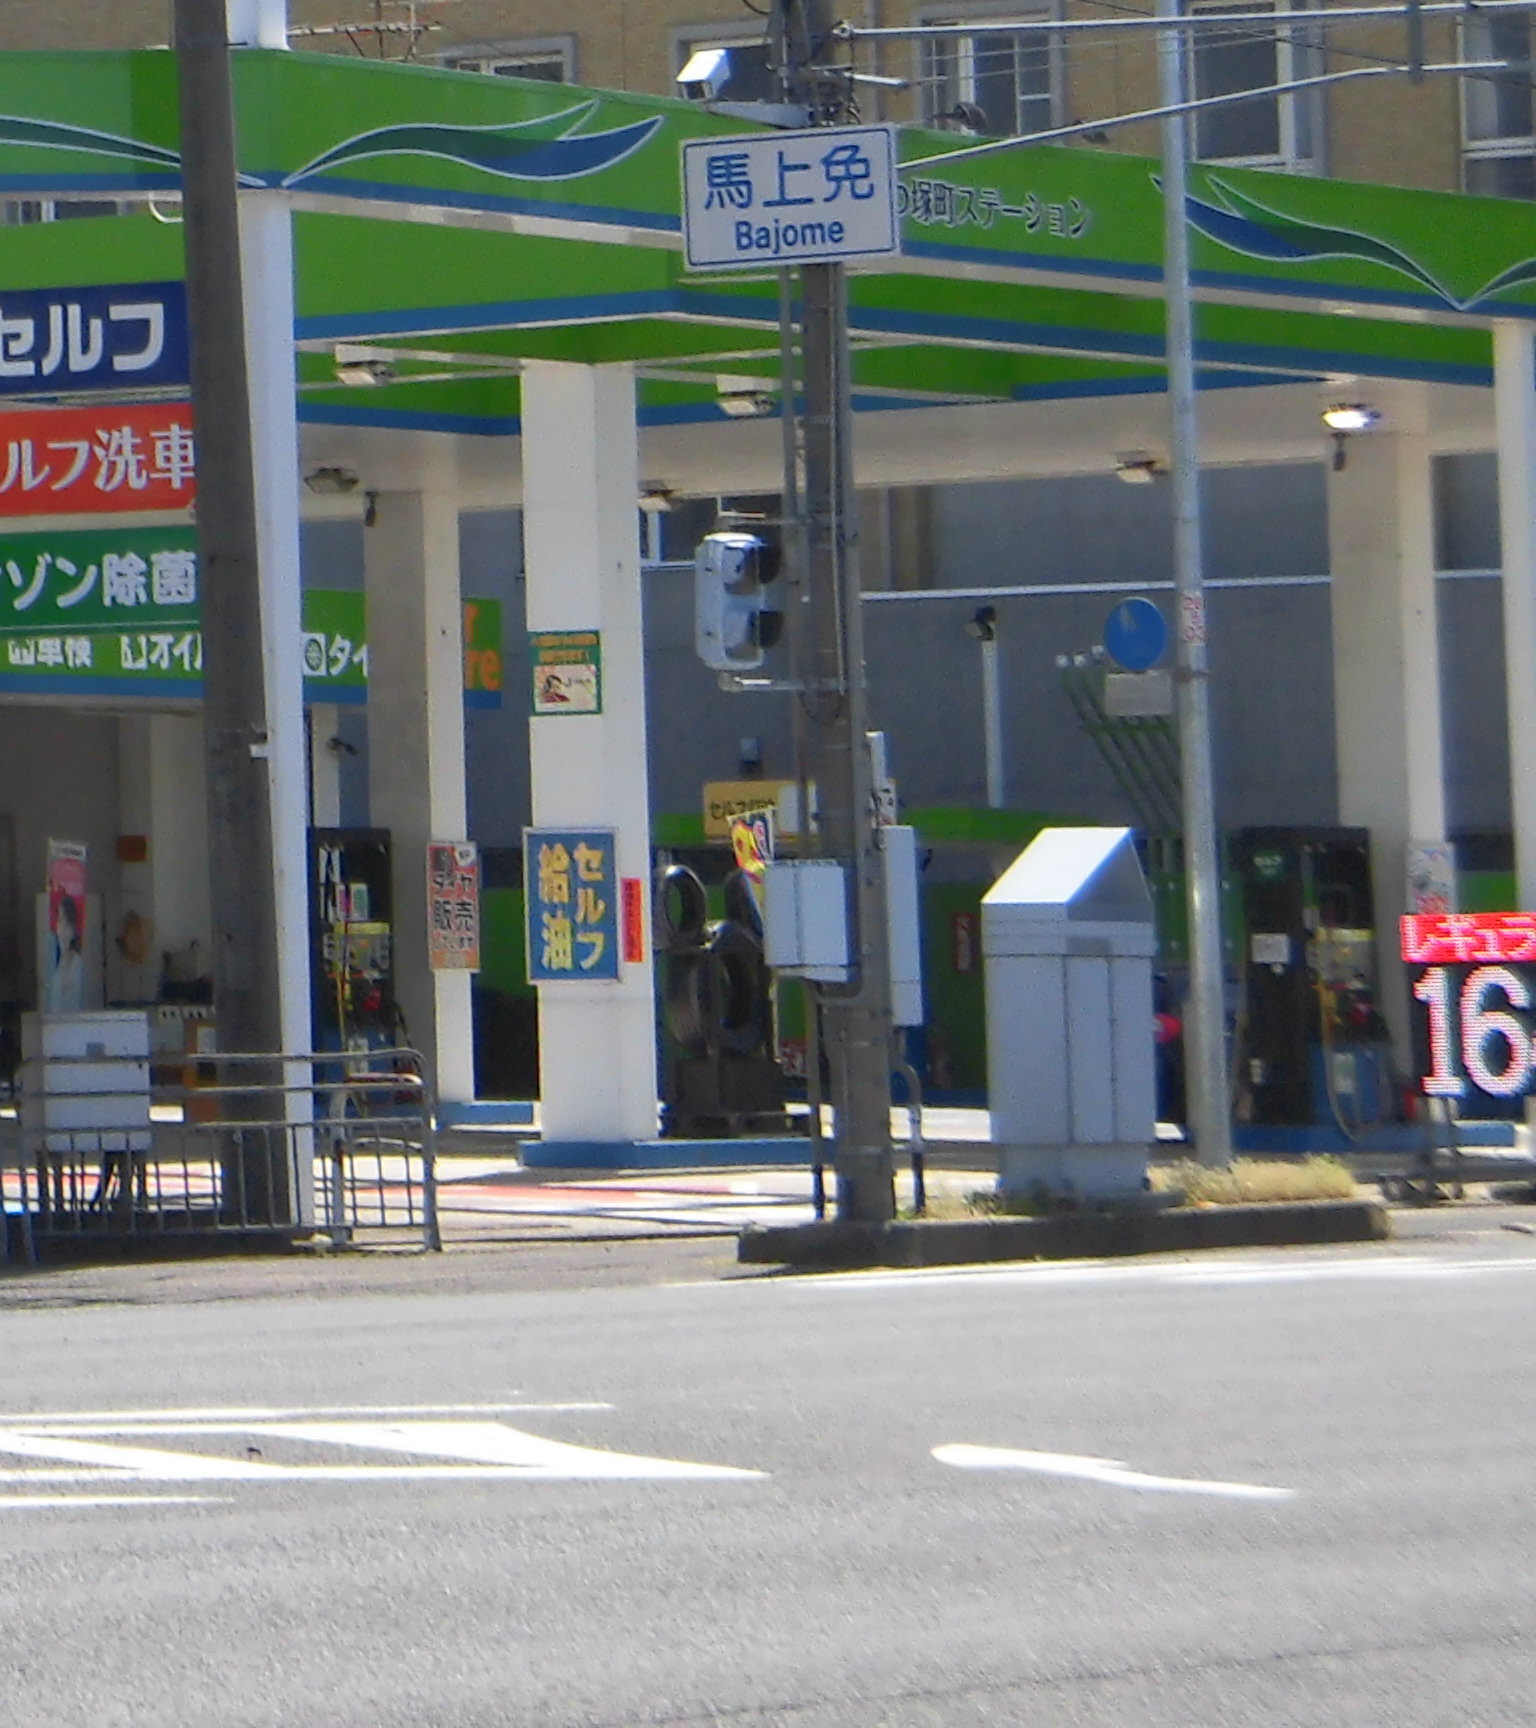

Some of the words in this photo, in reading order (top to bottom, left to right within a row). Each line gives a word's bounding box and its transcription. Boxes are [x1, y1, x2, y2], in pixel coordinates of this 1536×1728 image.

[702, 142, 877, 211] 馬上免
[733, 218, 845, 256] Bajome
[538, 841, 574, 972] 給油
[573, 840, 607, 971] セルフ
[1413, 964, 1536, 1097] 16
